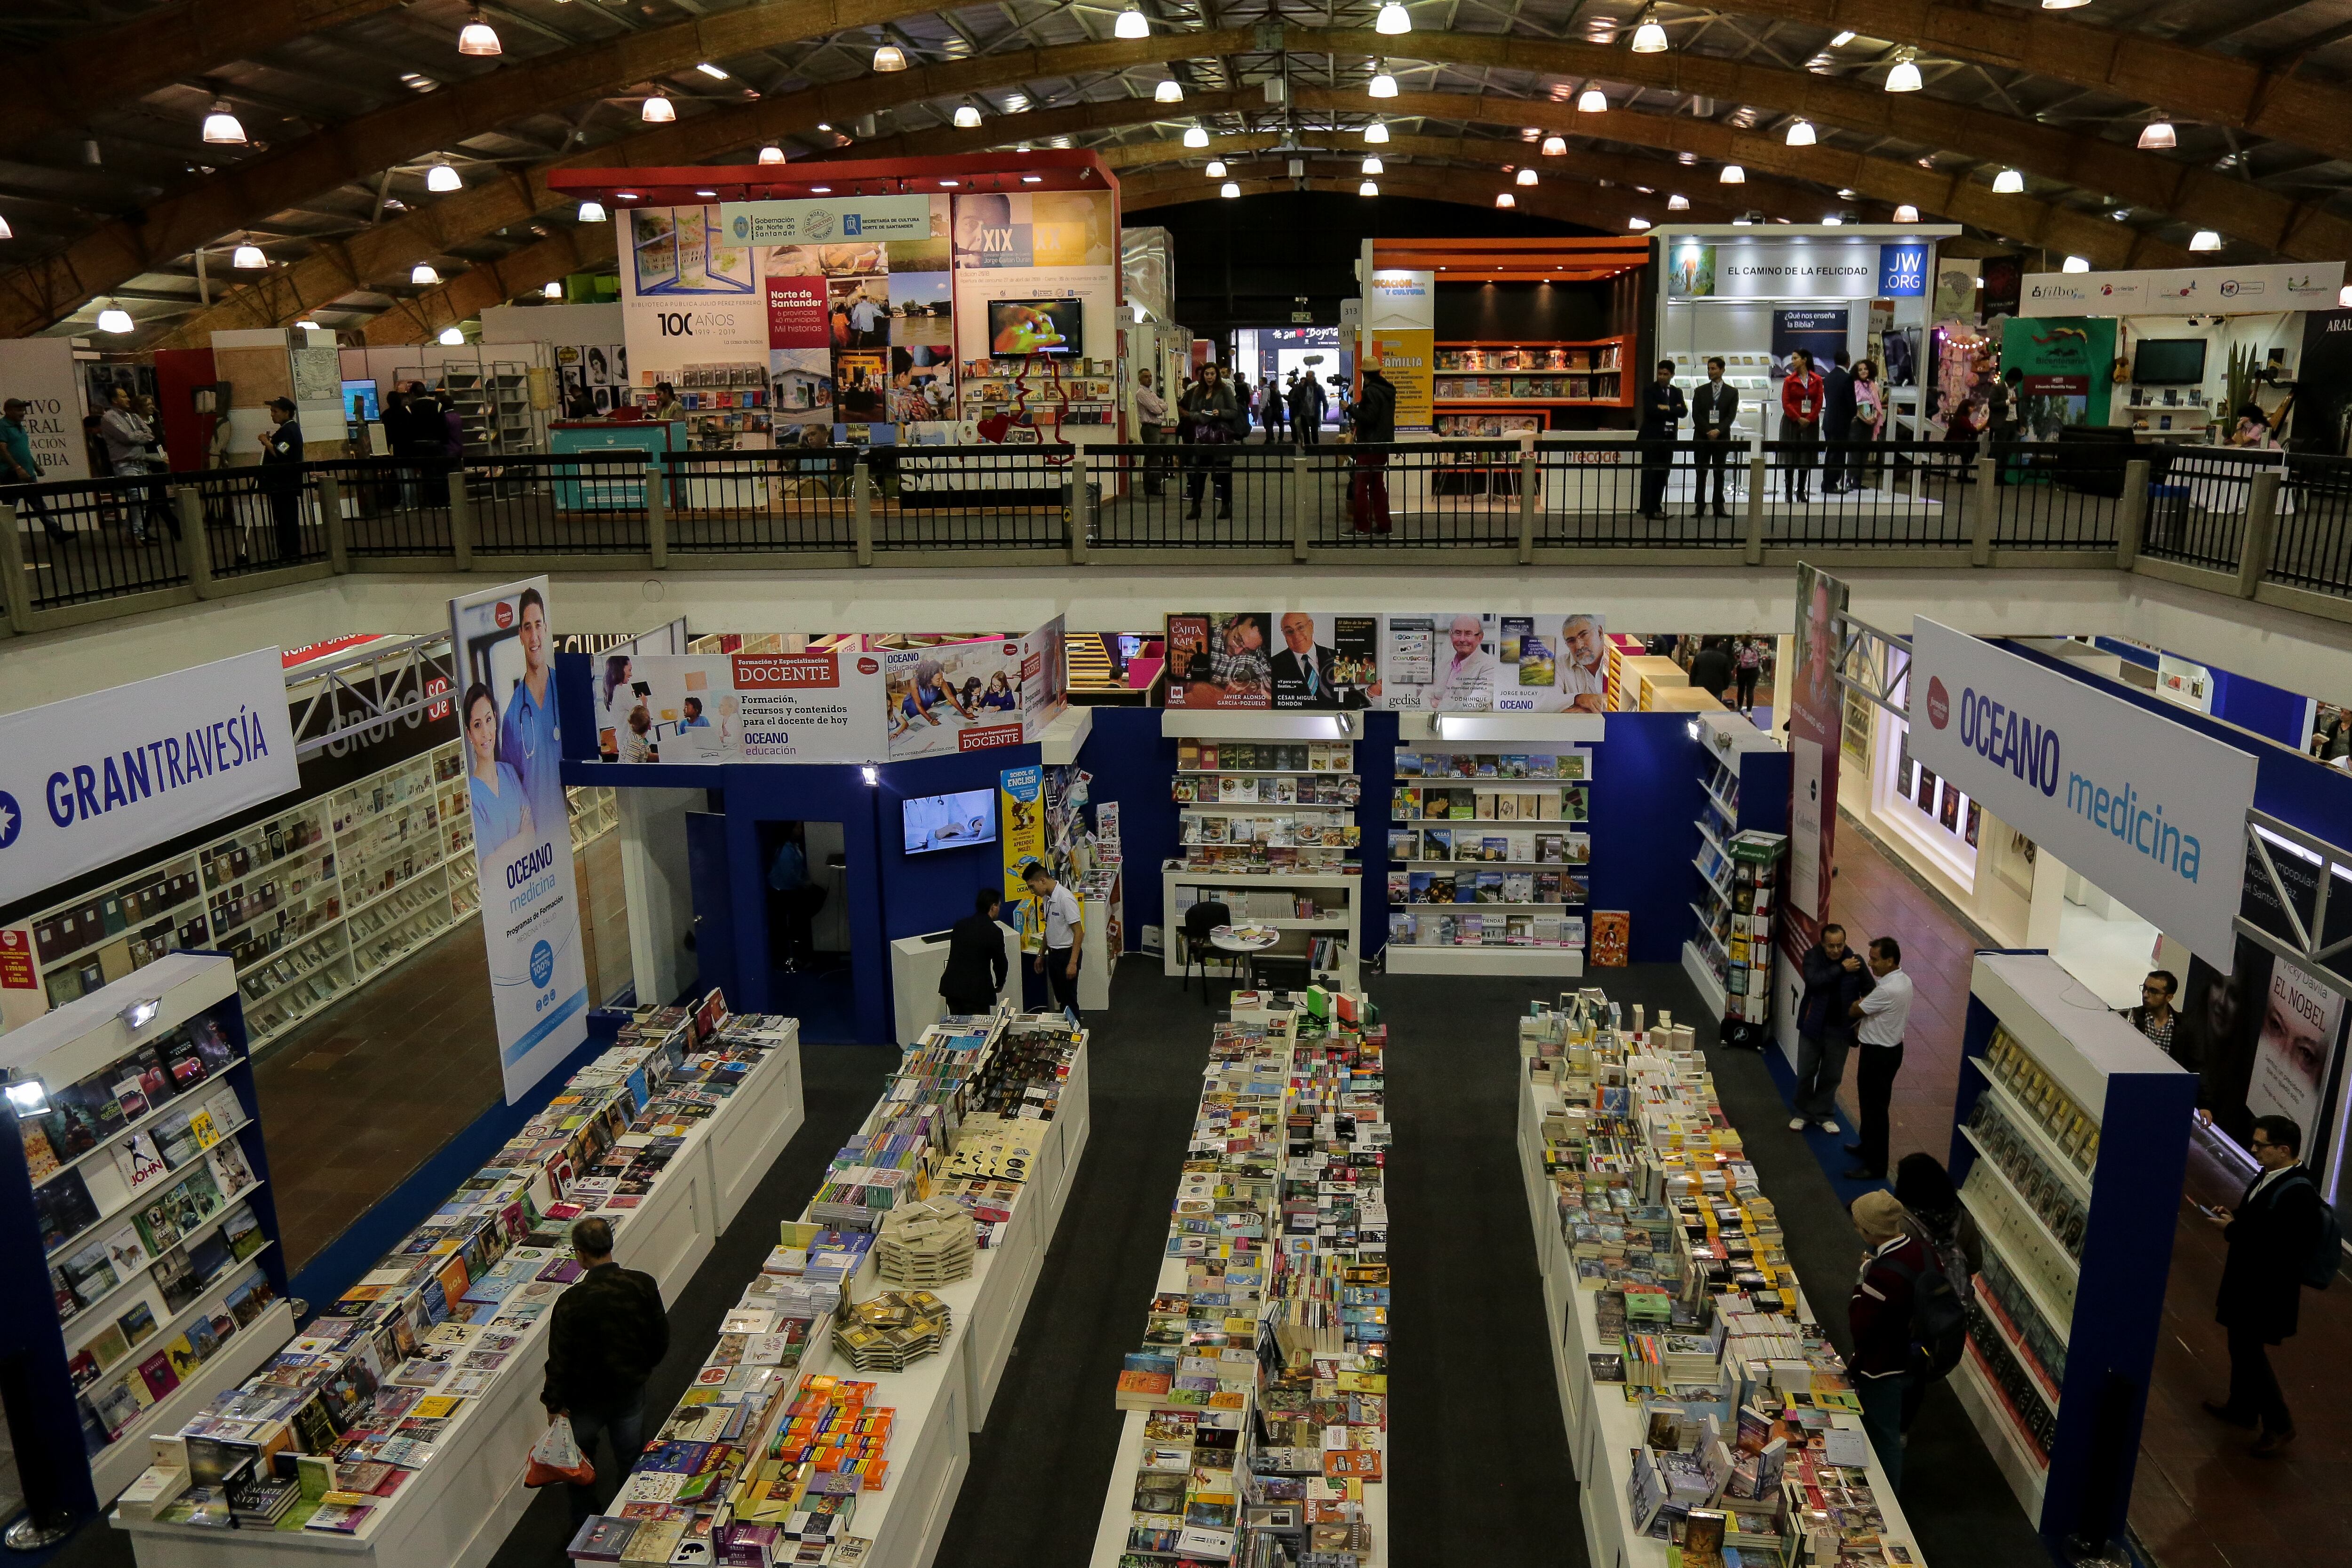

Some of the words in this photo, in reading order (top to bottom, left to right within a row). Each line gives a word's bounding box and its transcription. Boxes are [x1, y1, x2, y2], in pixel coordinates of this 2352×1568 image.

[804, 216, 834, 233] PRODUCTIVO
[983, 229, 1013, 252] XIX
[1035, 228, 1061, 251] XX
[1889, 253, 1922, 272] JW
[1743, 267, 1782, 276] CAMINO
[1785, 267, 1799, 276] DE
[1816, 267, 1868, 276] FELICIDAD
[1886, 274, 1921, 290] .ORG
[771, 291, 798, 299] Norte
[799, 290, 812, 298] de
[771, 299, 822, 308] Santander
[695, 312, 735, 326] AÑOS
[1785, 312, 1801, 321] ¿Qué
[1272, 329, 1282, 339] te
[1172, 626, 1205, 635] CAJITA
[887, 652, 919, 664] OCEANO
[739, 666, 831, 681] DOCENTE
[1024, 660, 1040, 677] DOCENTE
[741, 694, 798, 705] Formación,
[1334, 687, 1349, 703] T
[1389, 694, 1421, 708] gedisa
[786, 707, 792, 716] y
[794, 705, 847, 714] contenidos
[1500, 700, 1534, 710] OCEANO
[326, 689, 423, 758] GRUPO
[743, 718, 764, 728] para
[767, 717, 776, 725] el
[778, 716, 815, 725] docente
[817, 715, 828, 724] de
[831, 715, 848, 726] hoy
[745, 732, 788, 744] OCEANO
[963, 733, 1019, 749] DOCENTE
[1960, 687, 2060, 798] OCEANO
[745, 745, 796, 755] educación
[46, 704, 269, 828] GRANTRAVESÍA
[1008, 776, 1036, 788] ENGLISH
[2067, 770, 2201, 884] medicina
[1738, 850, 1766, 859] salamandra
[506, 842, 553, 889] OCEANO
[509, 873, 556, 914] medicina
[506, 915, 532, 938] Programas
[533, 912, 539, 920] de
[540, 895, 564, 916] Formación
[2273, 975, 2286, 1000] EL
[2288, 986, 2326, 1033] NOBEL
[130, 1159, 164, 1187] JOHN
[448, 1276, 461, 1292] SOL
[339, 1403, 352, 1419] Moda
[345, 1396, 368, 1423] publicidad
[705, 1409, 729, 1442] DIPLODOCO
[1283, 1448, 1292, 1470] LOCAL
[251, 1487, 285, 1496] MARTE
[241, 1496, 275, 1505] VENUS
